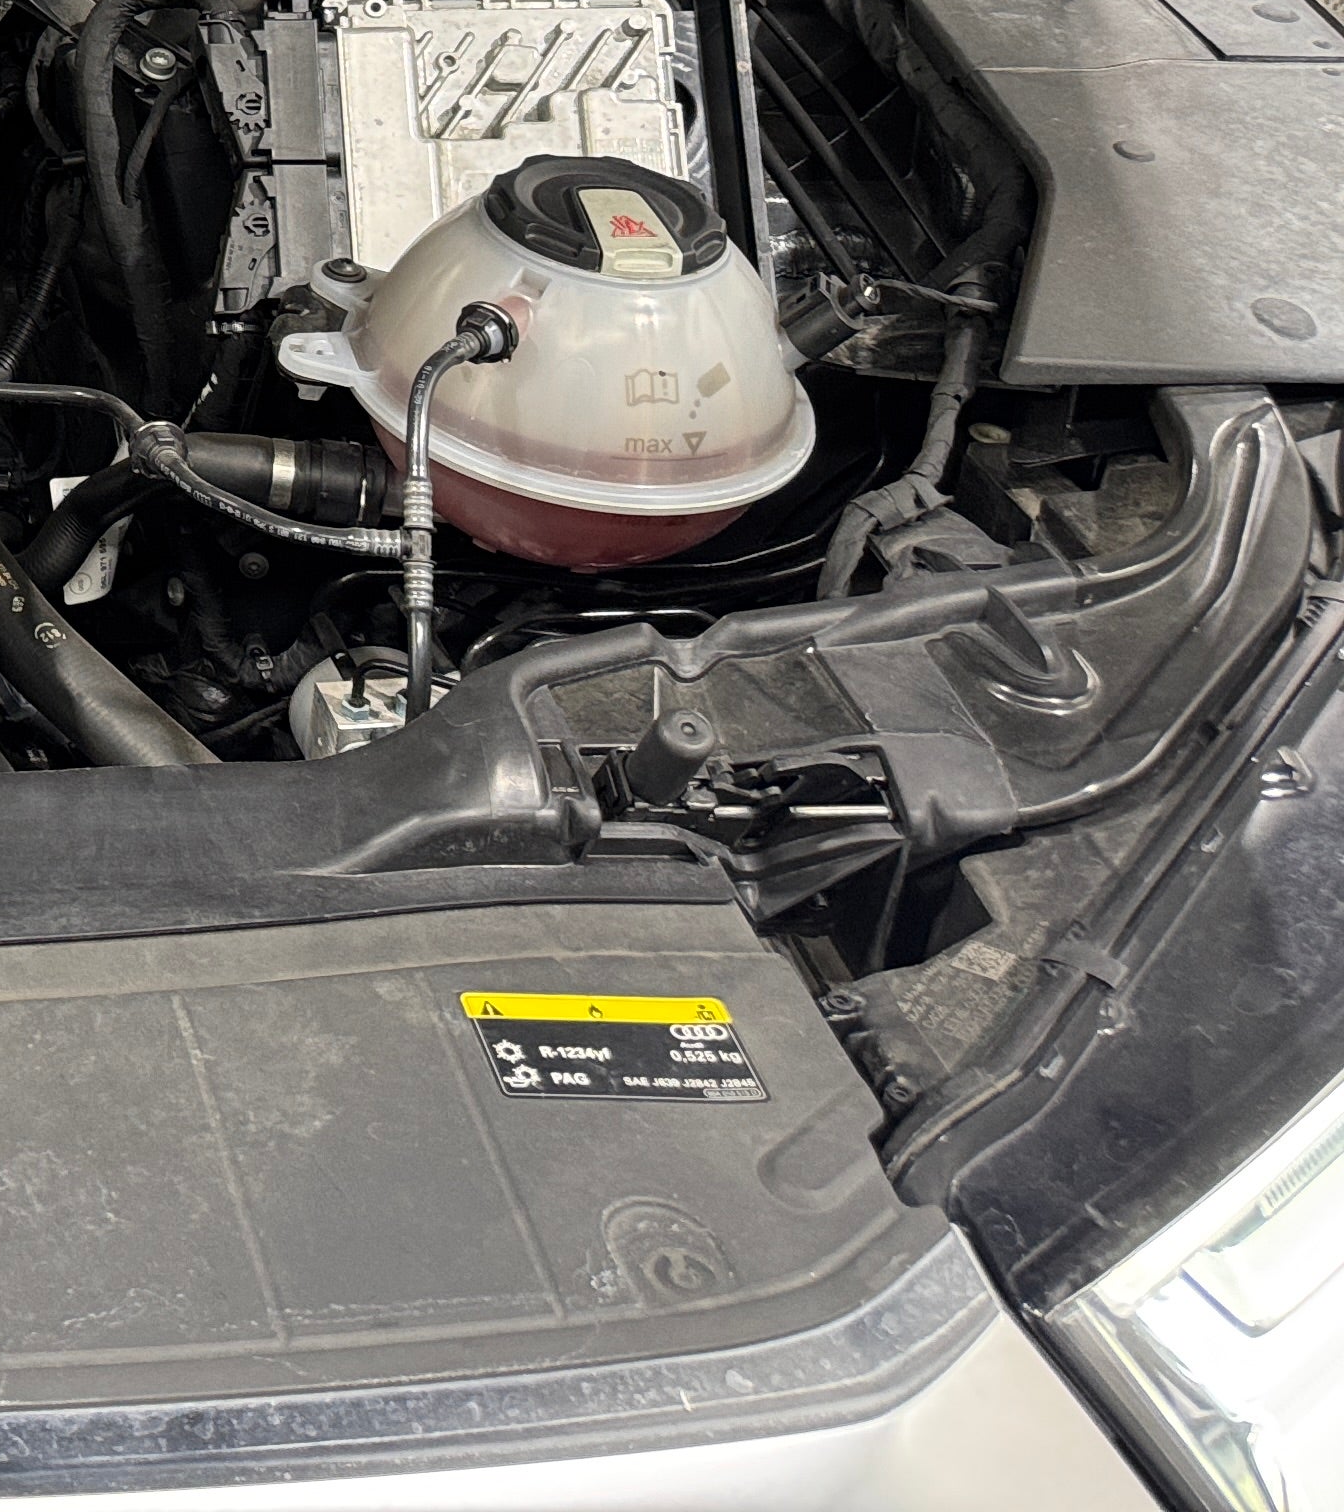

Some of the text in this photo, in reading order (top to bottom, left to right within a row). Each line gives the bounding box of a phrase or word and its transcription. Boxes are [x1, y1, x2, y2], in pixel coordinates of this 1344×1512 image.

[624, 437, 672, 454] max
[539, 1045, 743, 1064] R-1234yf 0,525 kg
[550, 1072, 590, 1085] PAG
[623, 1076, 647, 1086] SAE
